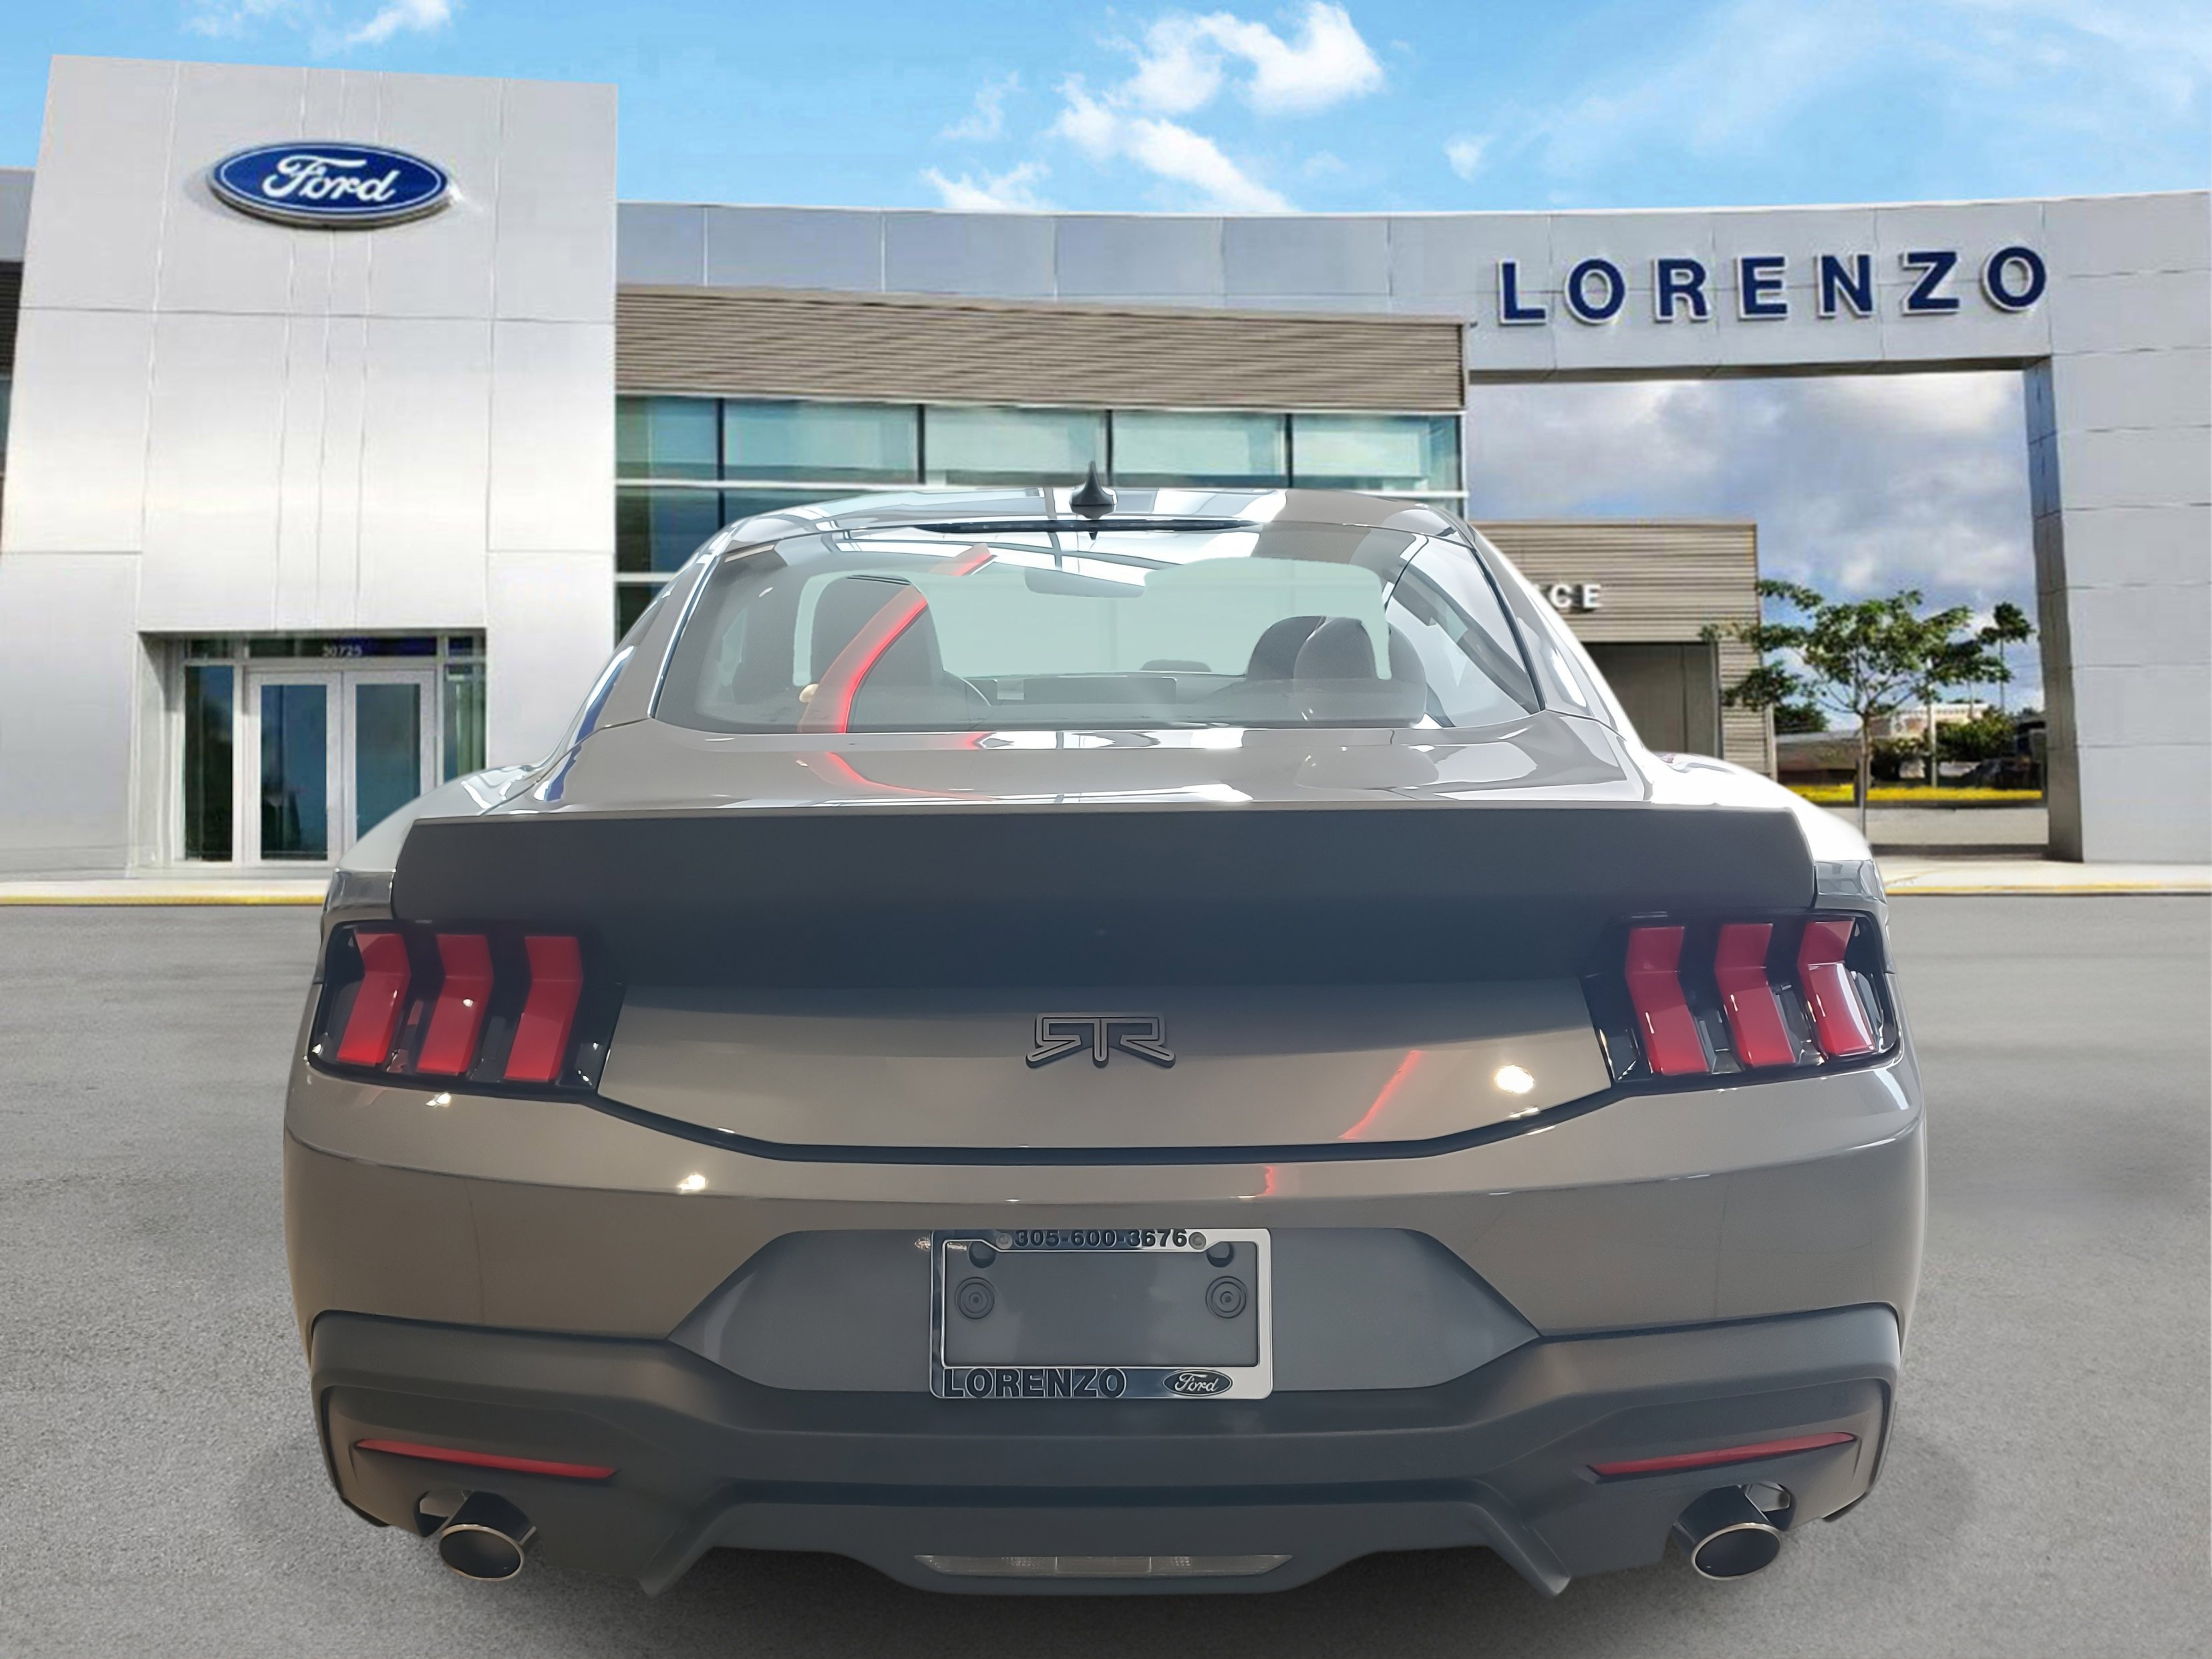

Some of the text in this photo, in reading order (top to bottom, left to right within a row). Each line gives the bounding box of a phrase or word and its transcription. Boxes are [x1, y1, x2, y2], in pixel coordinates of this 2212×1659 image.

[262, 154, 400, 202] Ford
[1498, 246, 2048, 325] LORENZO
[1534, 583, 1602, 609] CE
[1013, 1229, 1188, 1248] 305-600-3676
[943, 1368, 1219, 1398] LORENZO Ford
